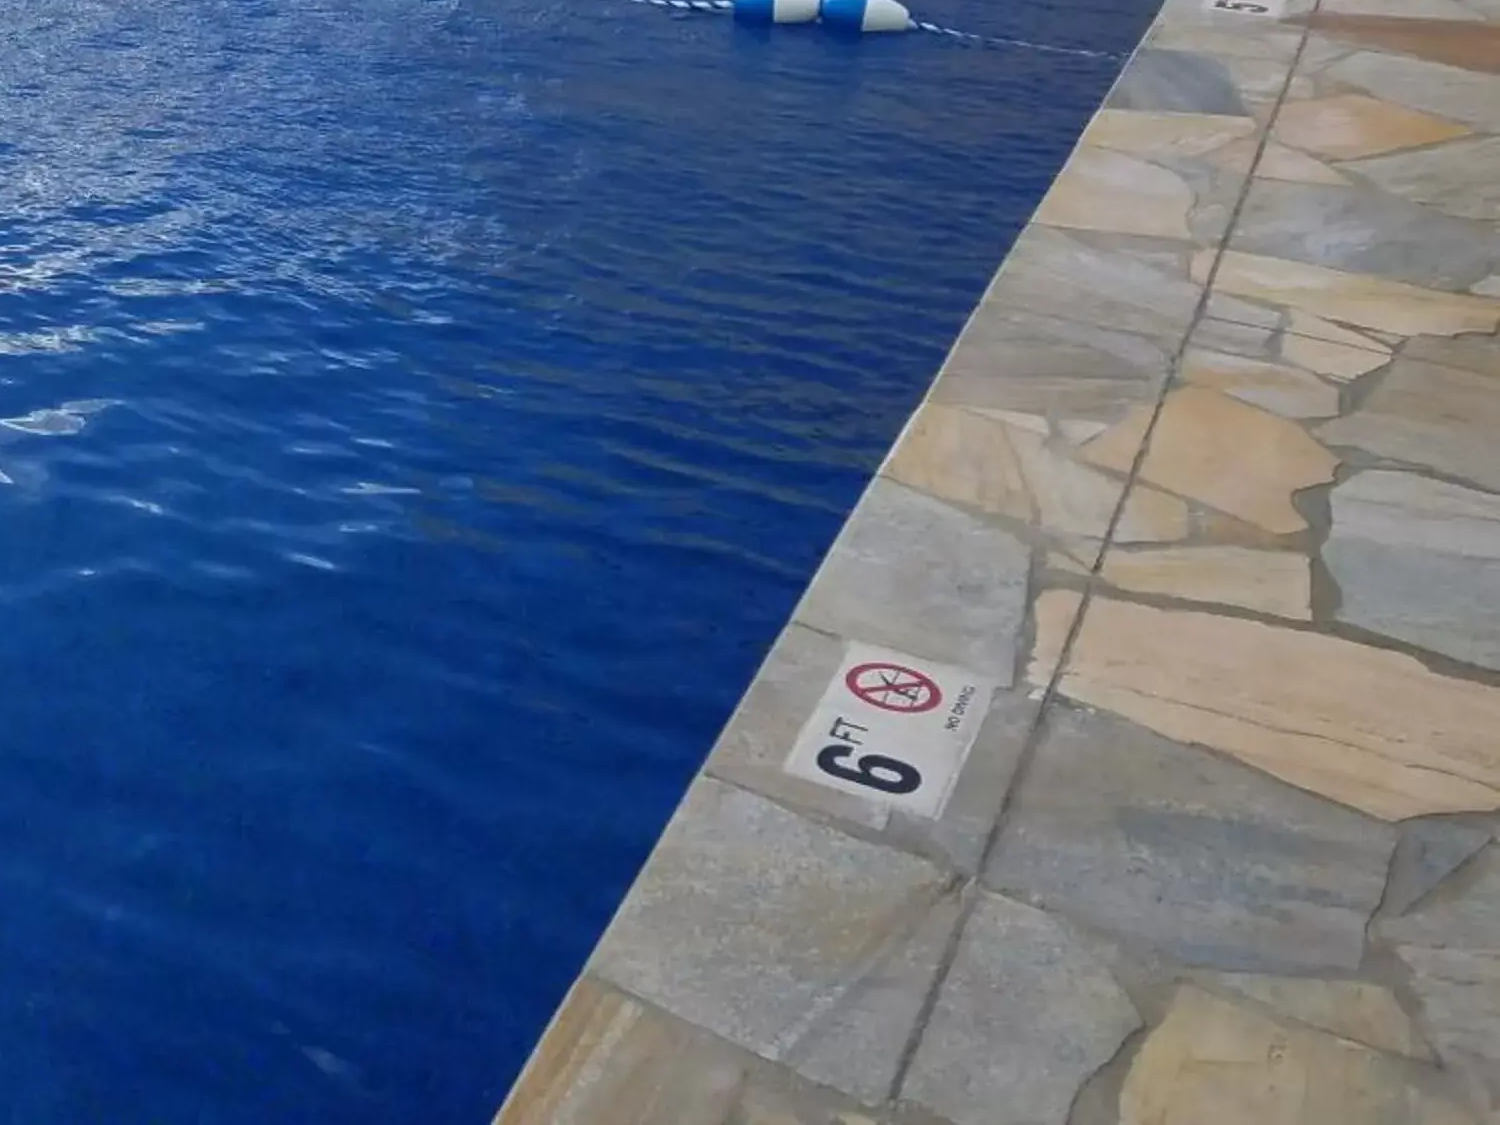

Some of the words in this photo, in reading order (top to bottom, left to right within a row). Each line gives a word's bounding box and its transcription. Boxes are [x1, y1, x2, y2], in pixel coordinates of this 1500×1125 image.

[951, 686, 977, 718] DIVING
[828, 716, 870, 746] FT
[943, 716, 962, 733] NO
[816, 744, 922, 794] 6
